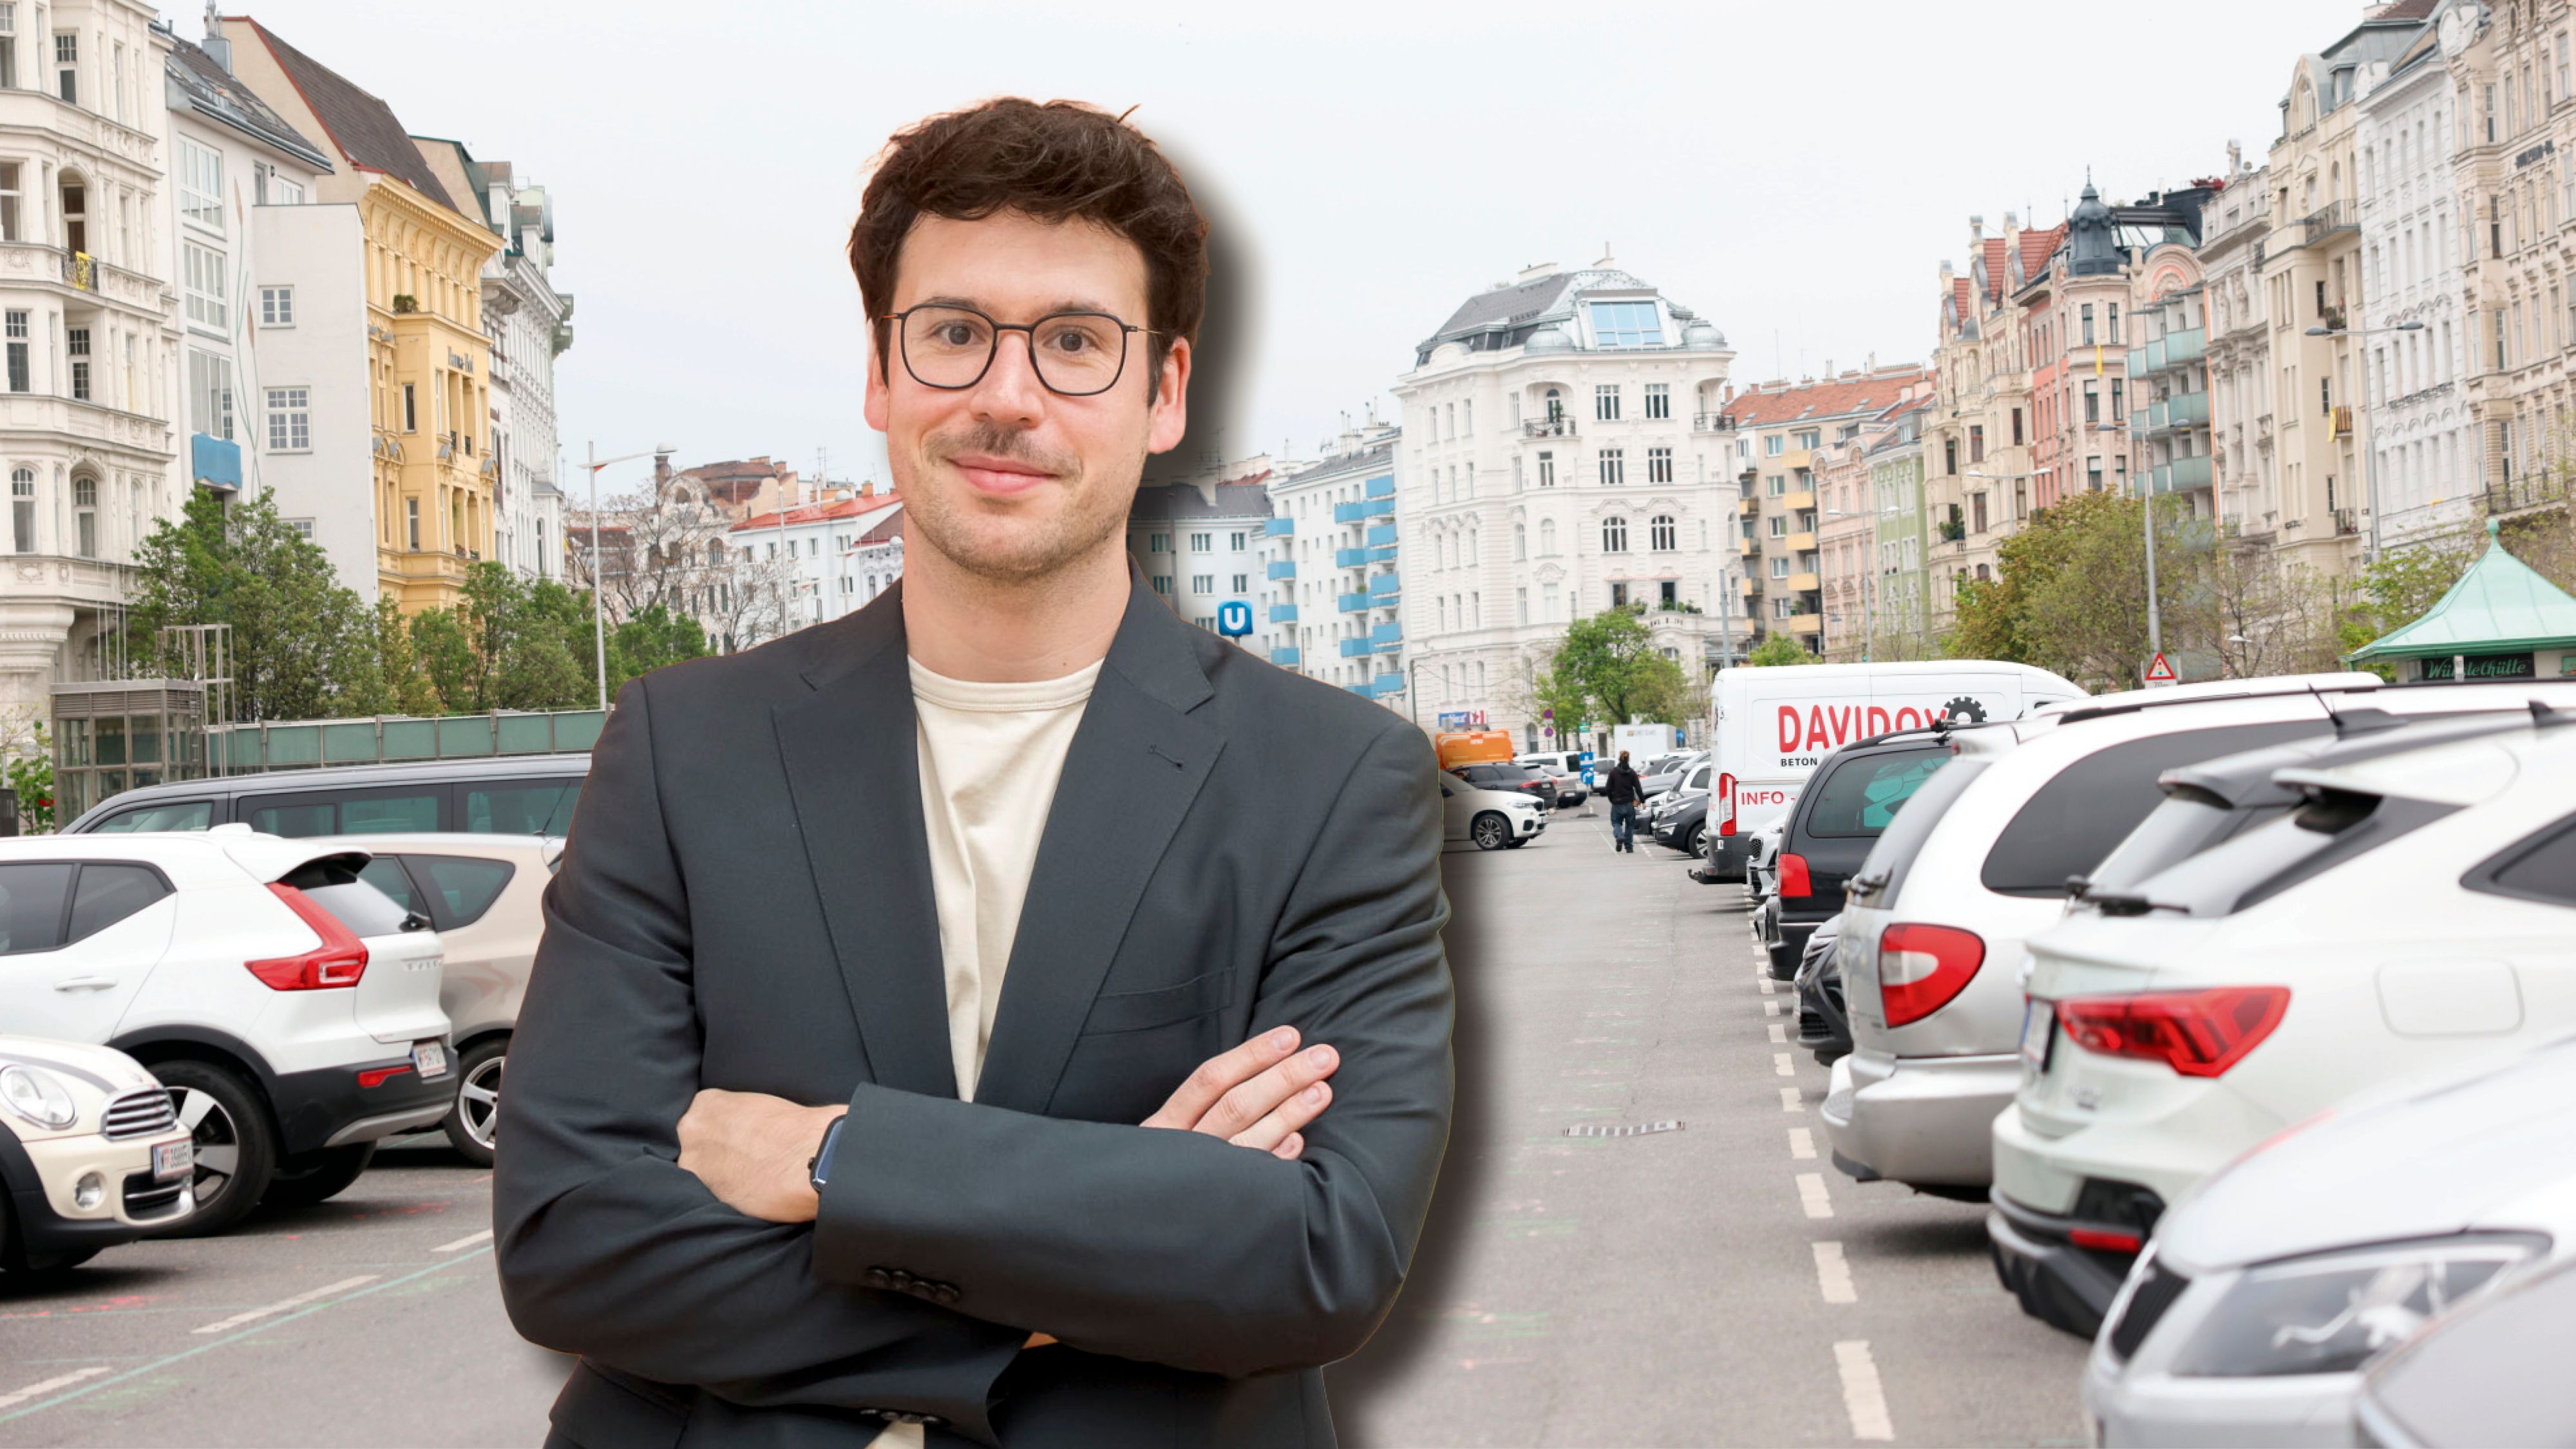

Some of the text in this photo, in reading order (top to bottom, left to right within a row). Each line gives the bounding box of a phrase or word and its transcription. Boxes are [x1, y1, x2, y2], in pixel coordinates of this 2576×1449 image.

[1224, 607, 1245, 630] U
[2427, 658, 2526, 679] Wütelhütte
[1781, 757, 1818, 767] BETON
[1741, 791, 1785, 805] INFO
